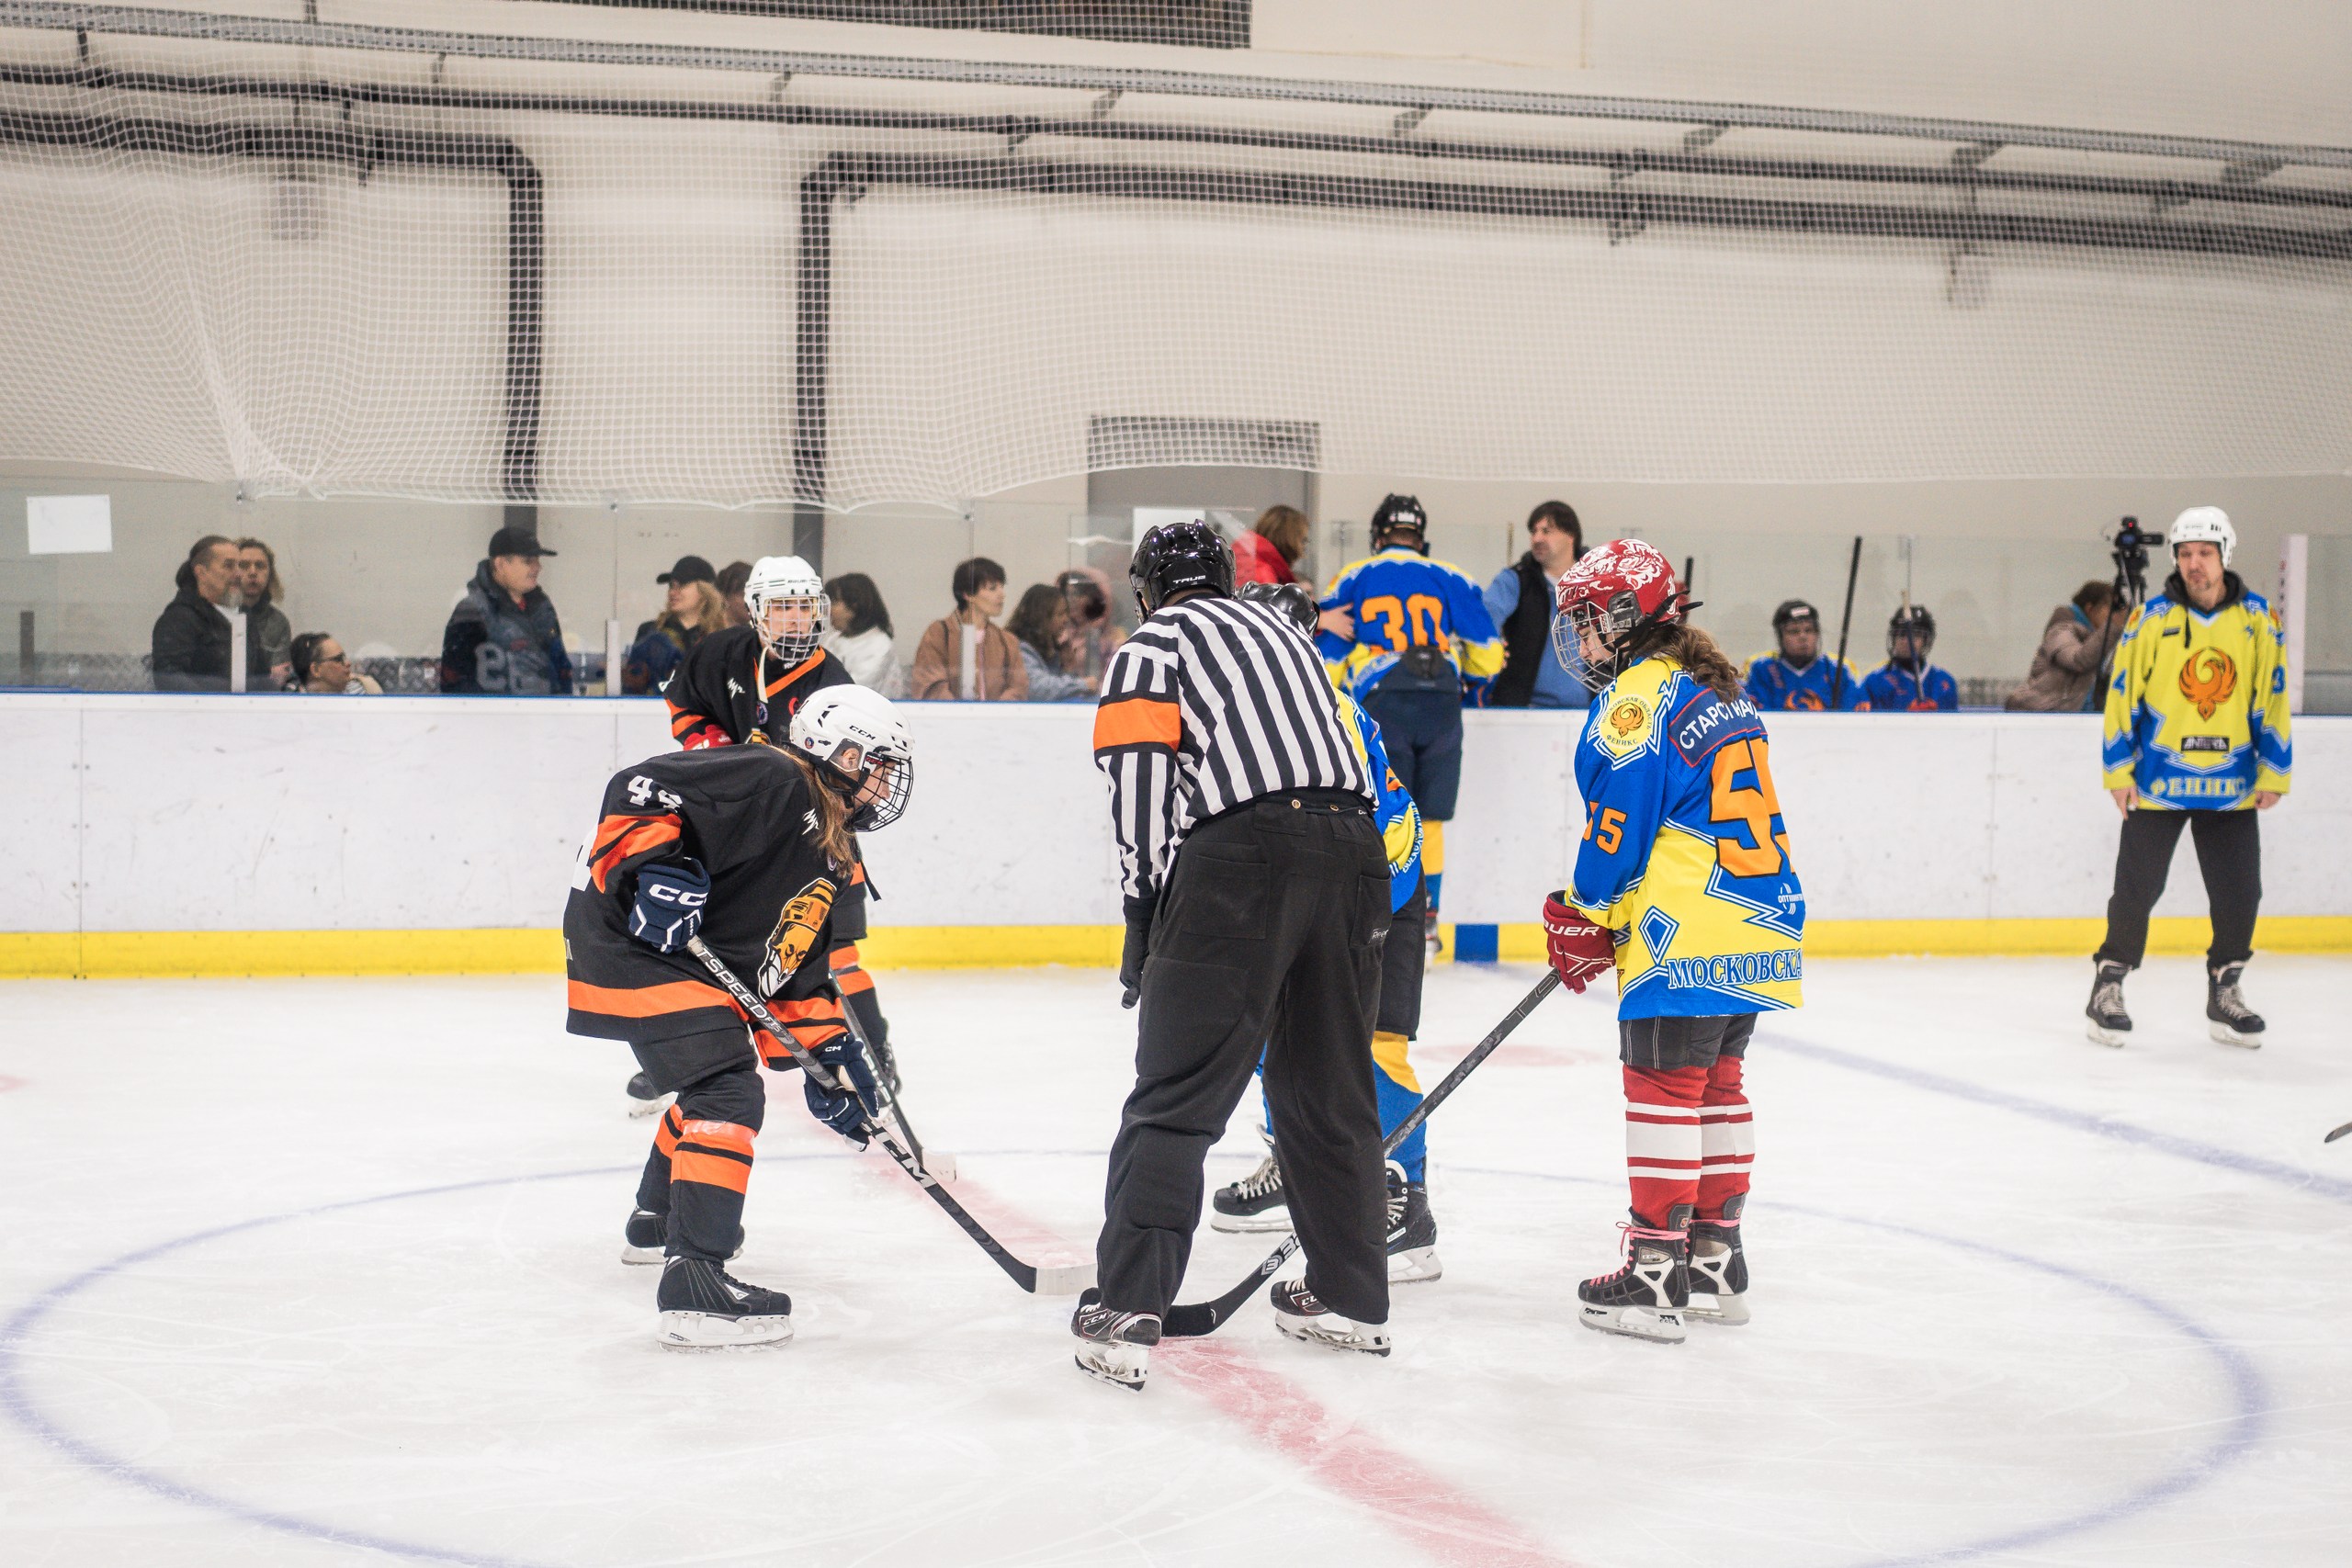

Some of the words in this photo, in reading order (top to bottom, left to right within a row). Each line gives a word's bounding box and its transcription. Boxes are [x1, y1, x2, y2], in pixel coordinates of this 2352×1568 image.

[1172, 575, 1206, 584] TRUE
[1361, 593, 1450, 653] 30
[849, 725, 876, 740] CCM
[1607, 734, 1638, 746] ФЕНИКС
[2149, 775, 2247, 797] ФЕНИКС
[649, 884, 708, 907] CC
[1666, 947, 1803, 990] МОСКОВСКА
[695, 947, 768, 1020] TSPEED
[824, 1044, 842, 1053] CM
[1082, 1312, 1108, 1326] CCM
